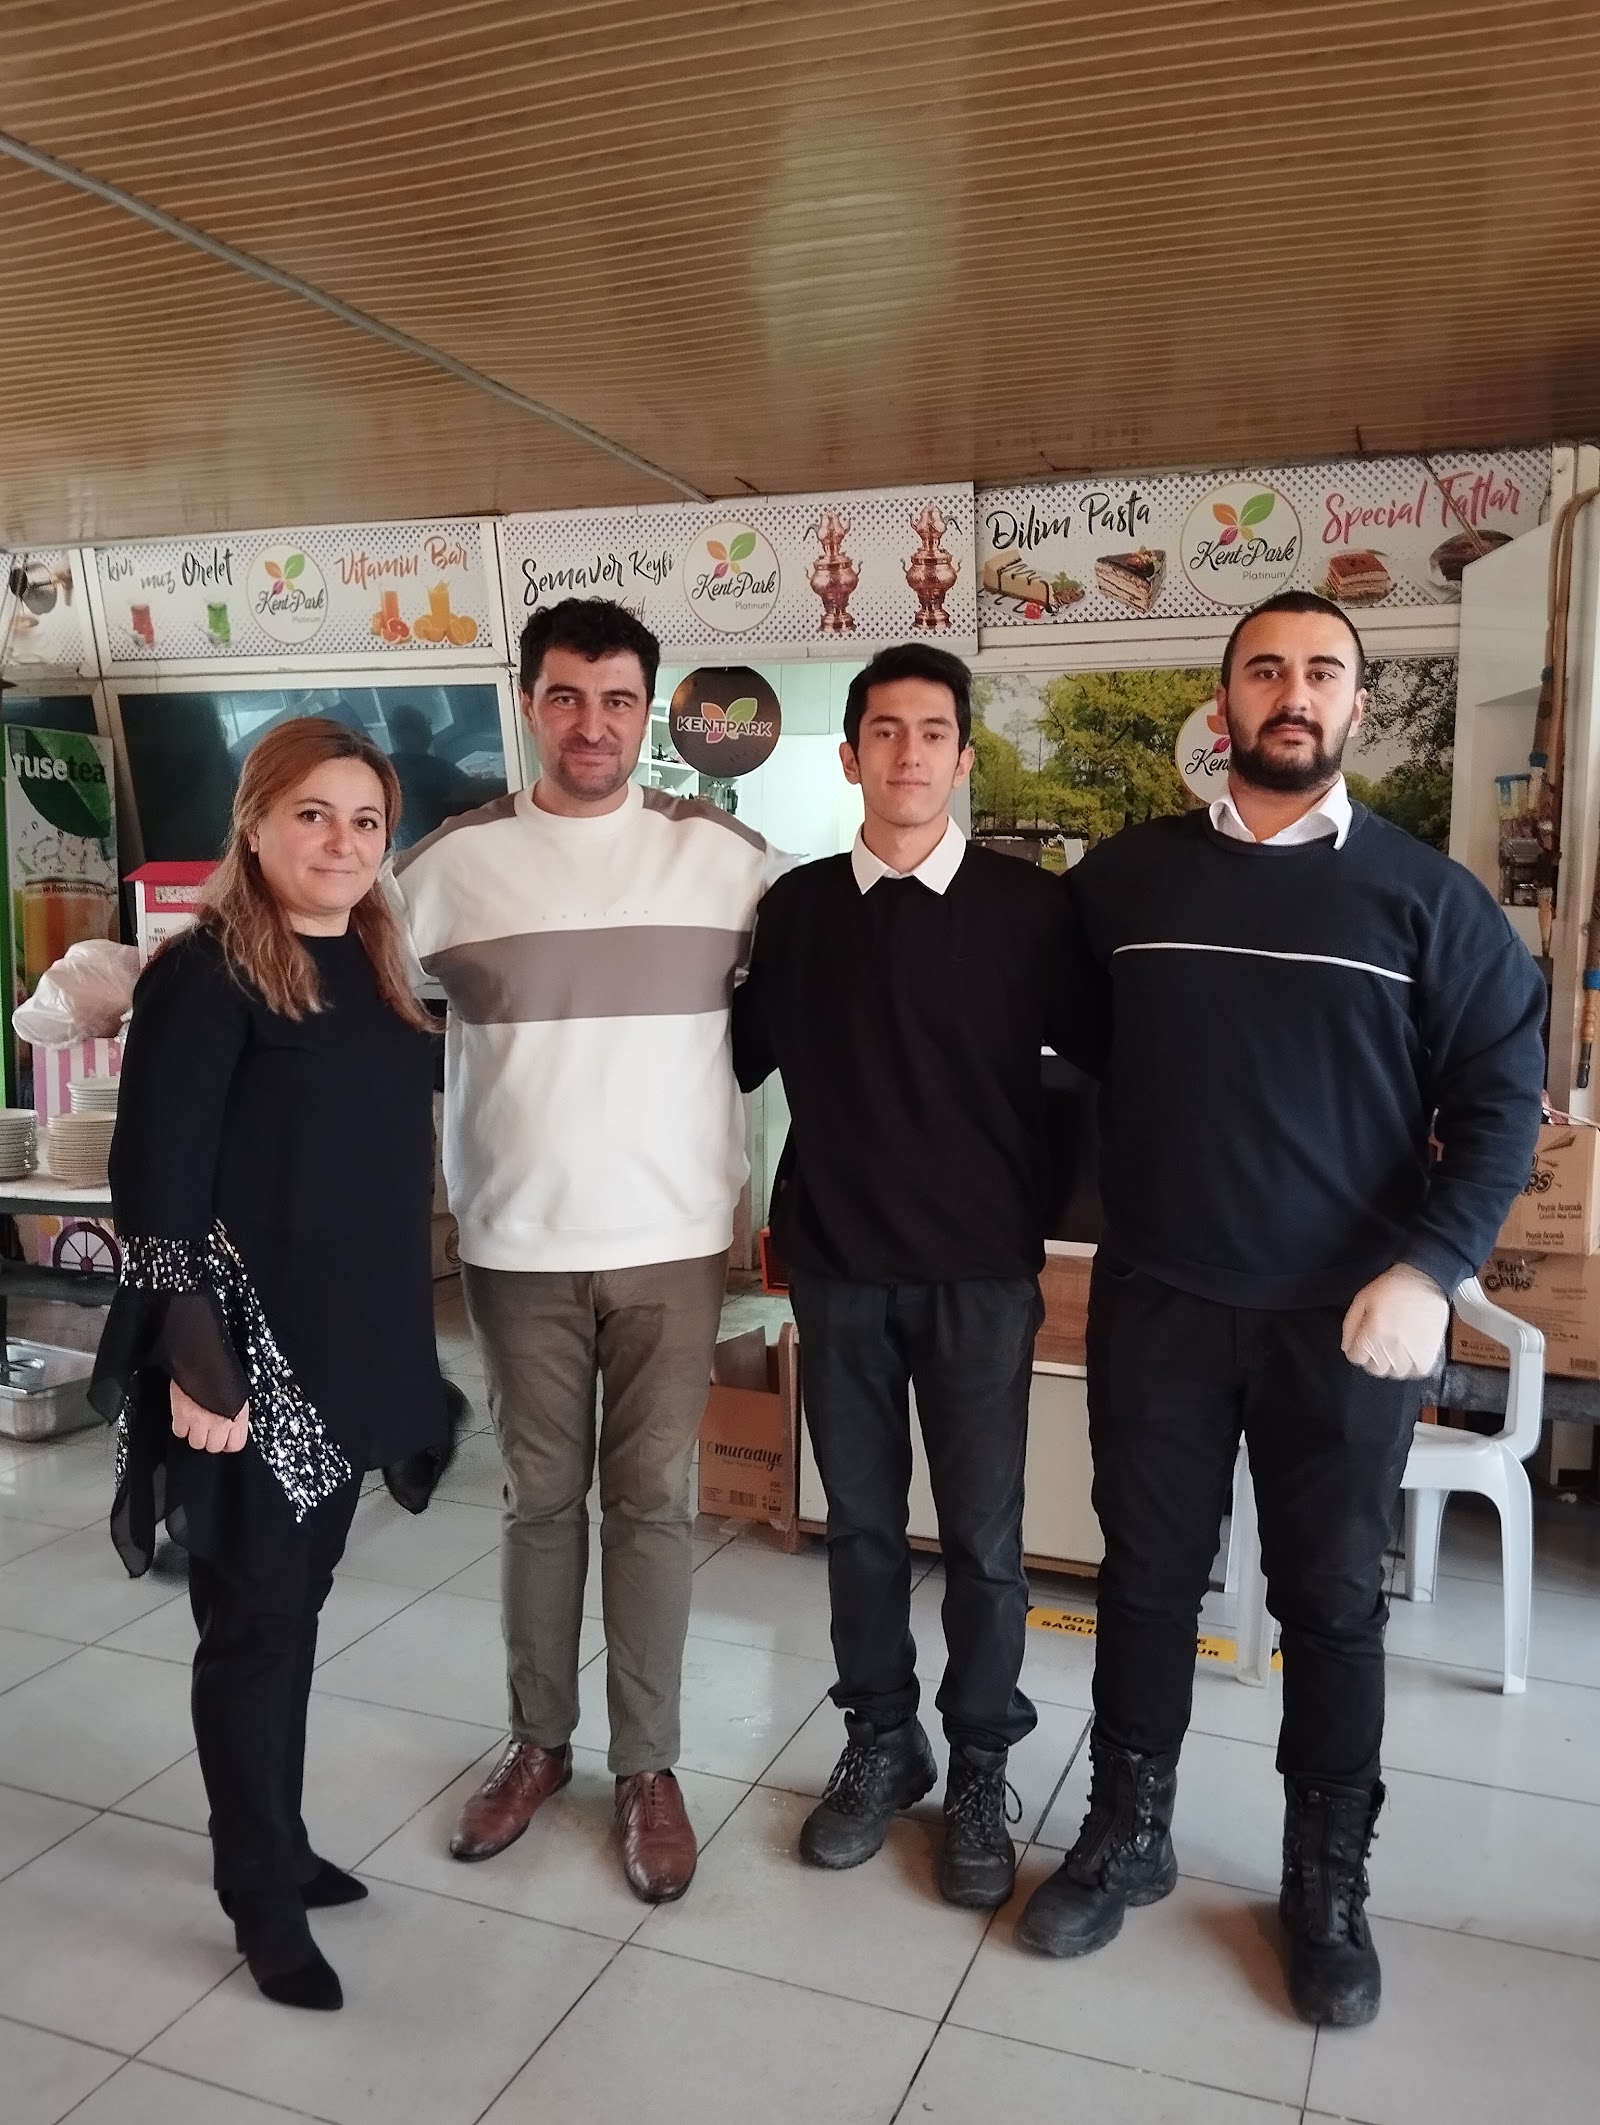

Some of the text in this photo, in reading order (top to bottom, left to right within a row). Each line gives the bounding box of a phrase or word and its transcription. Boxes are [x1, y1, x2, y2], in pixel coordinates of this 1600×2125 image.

[985, 490, 1150, 551] Dilim Pasta
[1322, 480, 1428, 544] Special
[334, 536, 469, 590] Vitamin Bar
[628, 550, 675, 585] Keyfi
[1242, 570, 1286, 581] Platinum
[676, 716, 773, 738] KENTPARK
[1184, 748, 1229, 776] Ken
